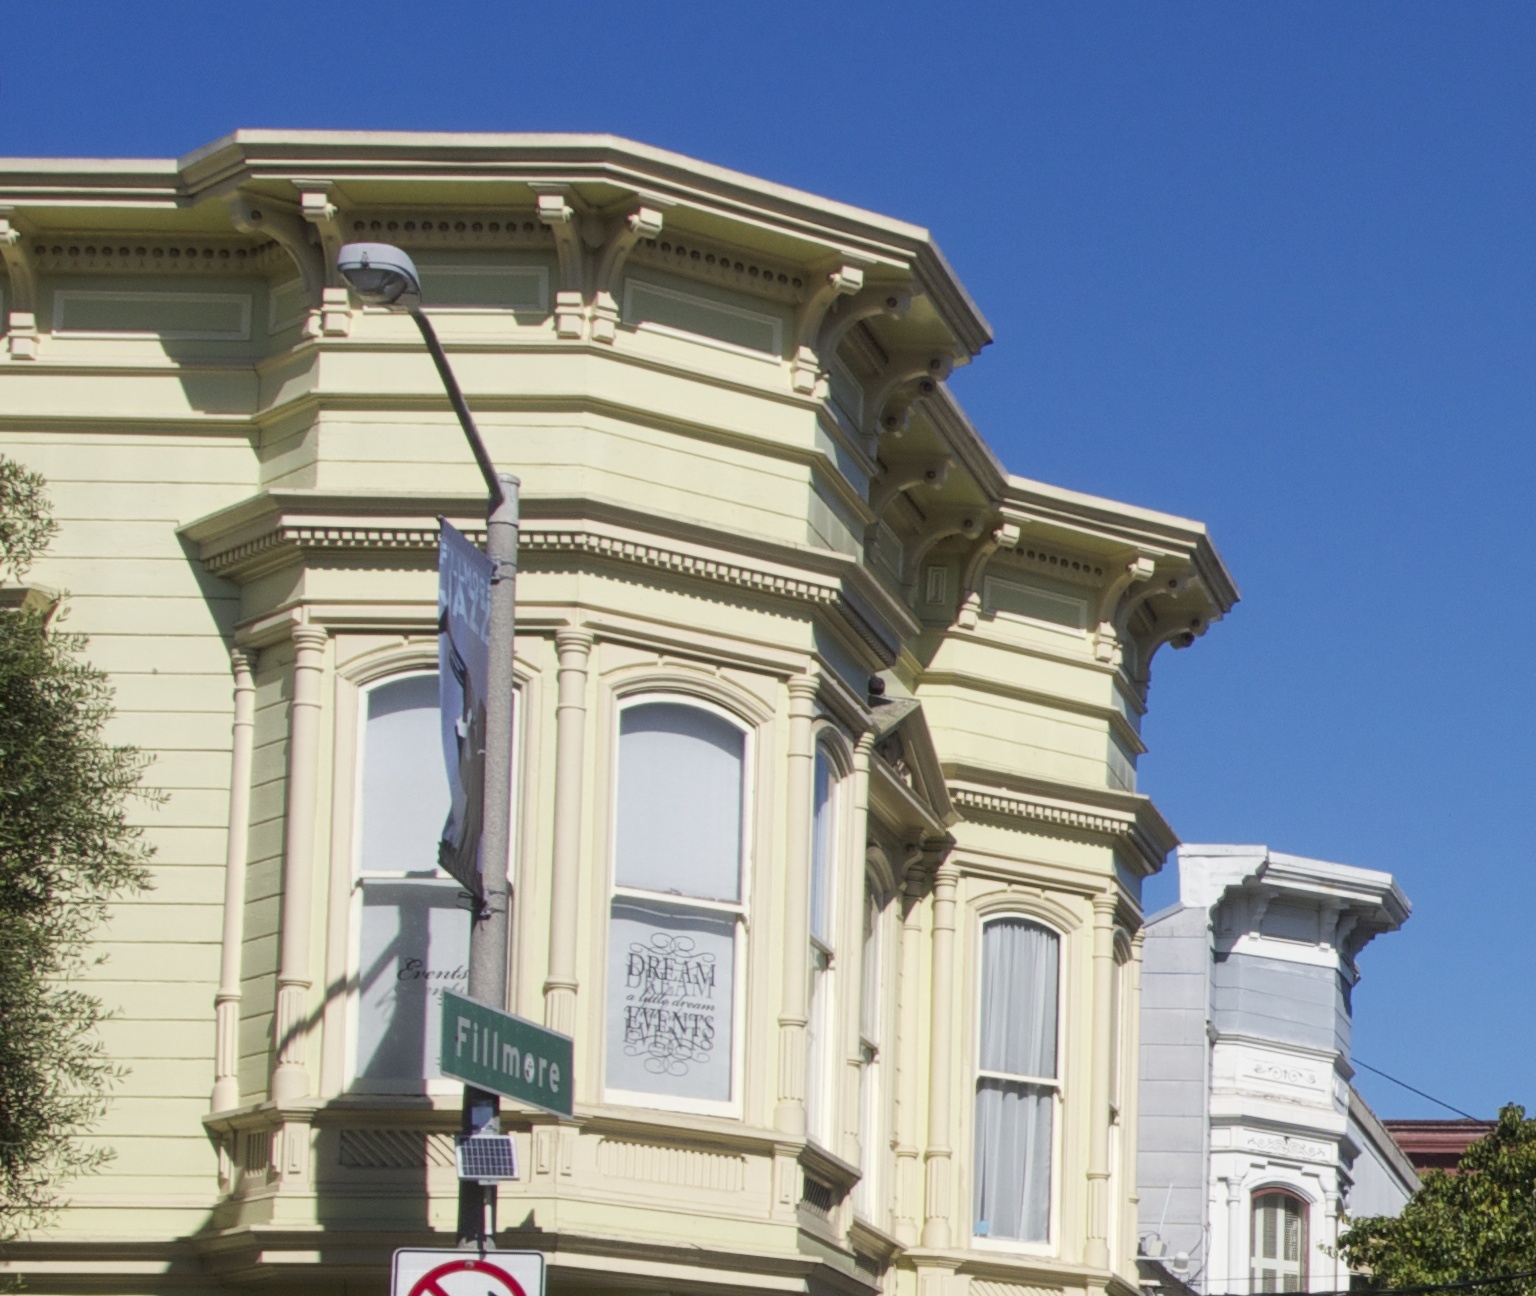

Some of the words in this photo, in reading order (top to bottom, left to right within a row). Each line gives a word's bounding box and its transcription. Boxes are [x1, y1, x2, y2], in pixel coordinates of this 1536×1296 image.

[627, 952, 716, 987] DREAM
[625, 1005, 715, 1041] EVENTS
[456, 1014, 560, 1093] Fillmore
